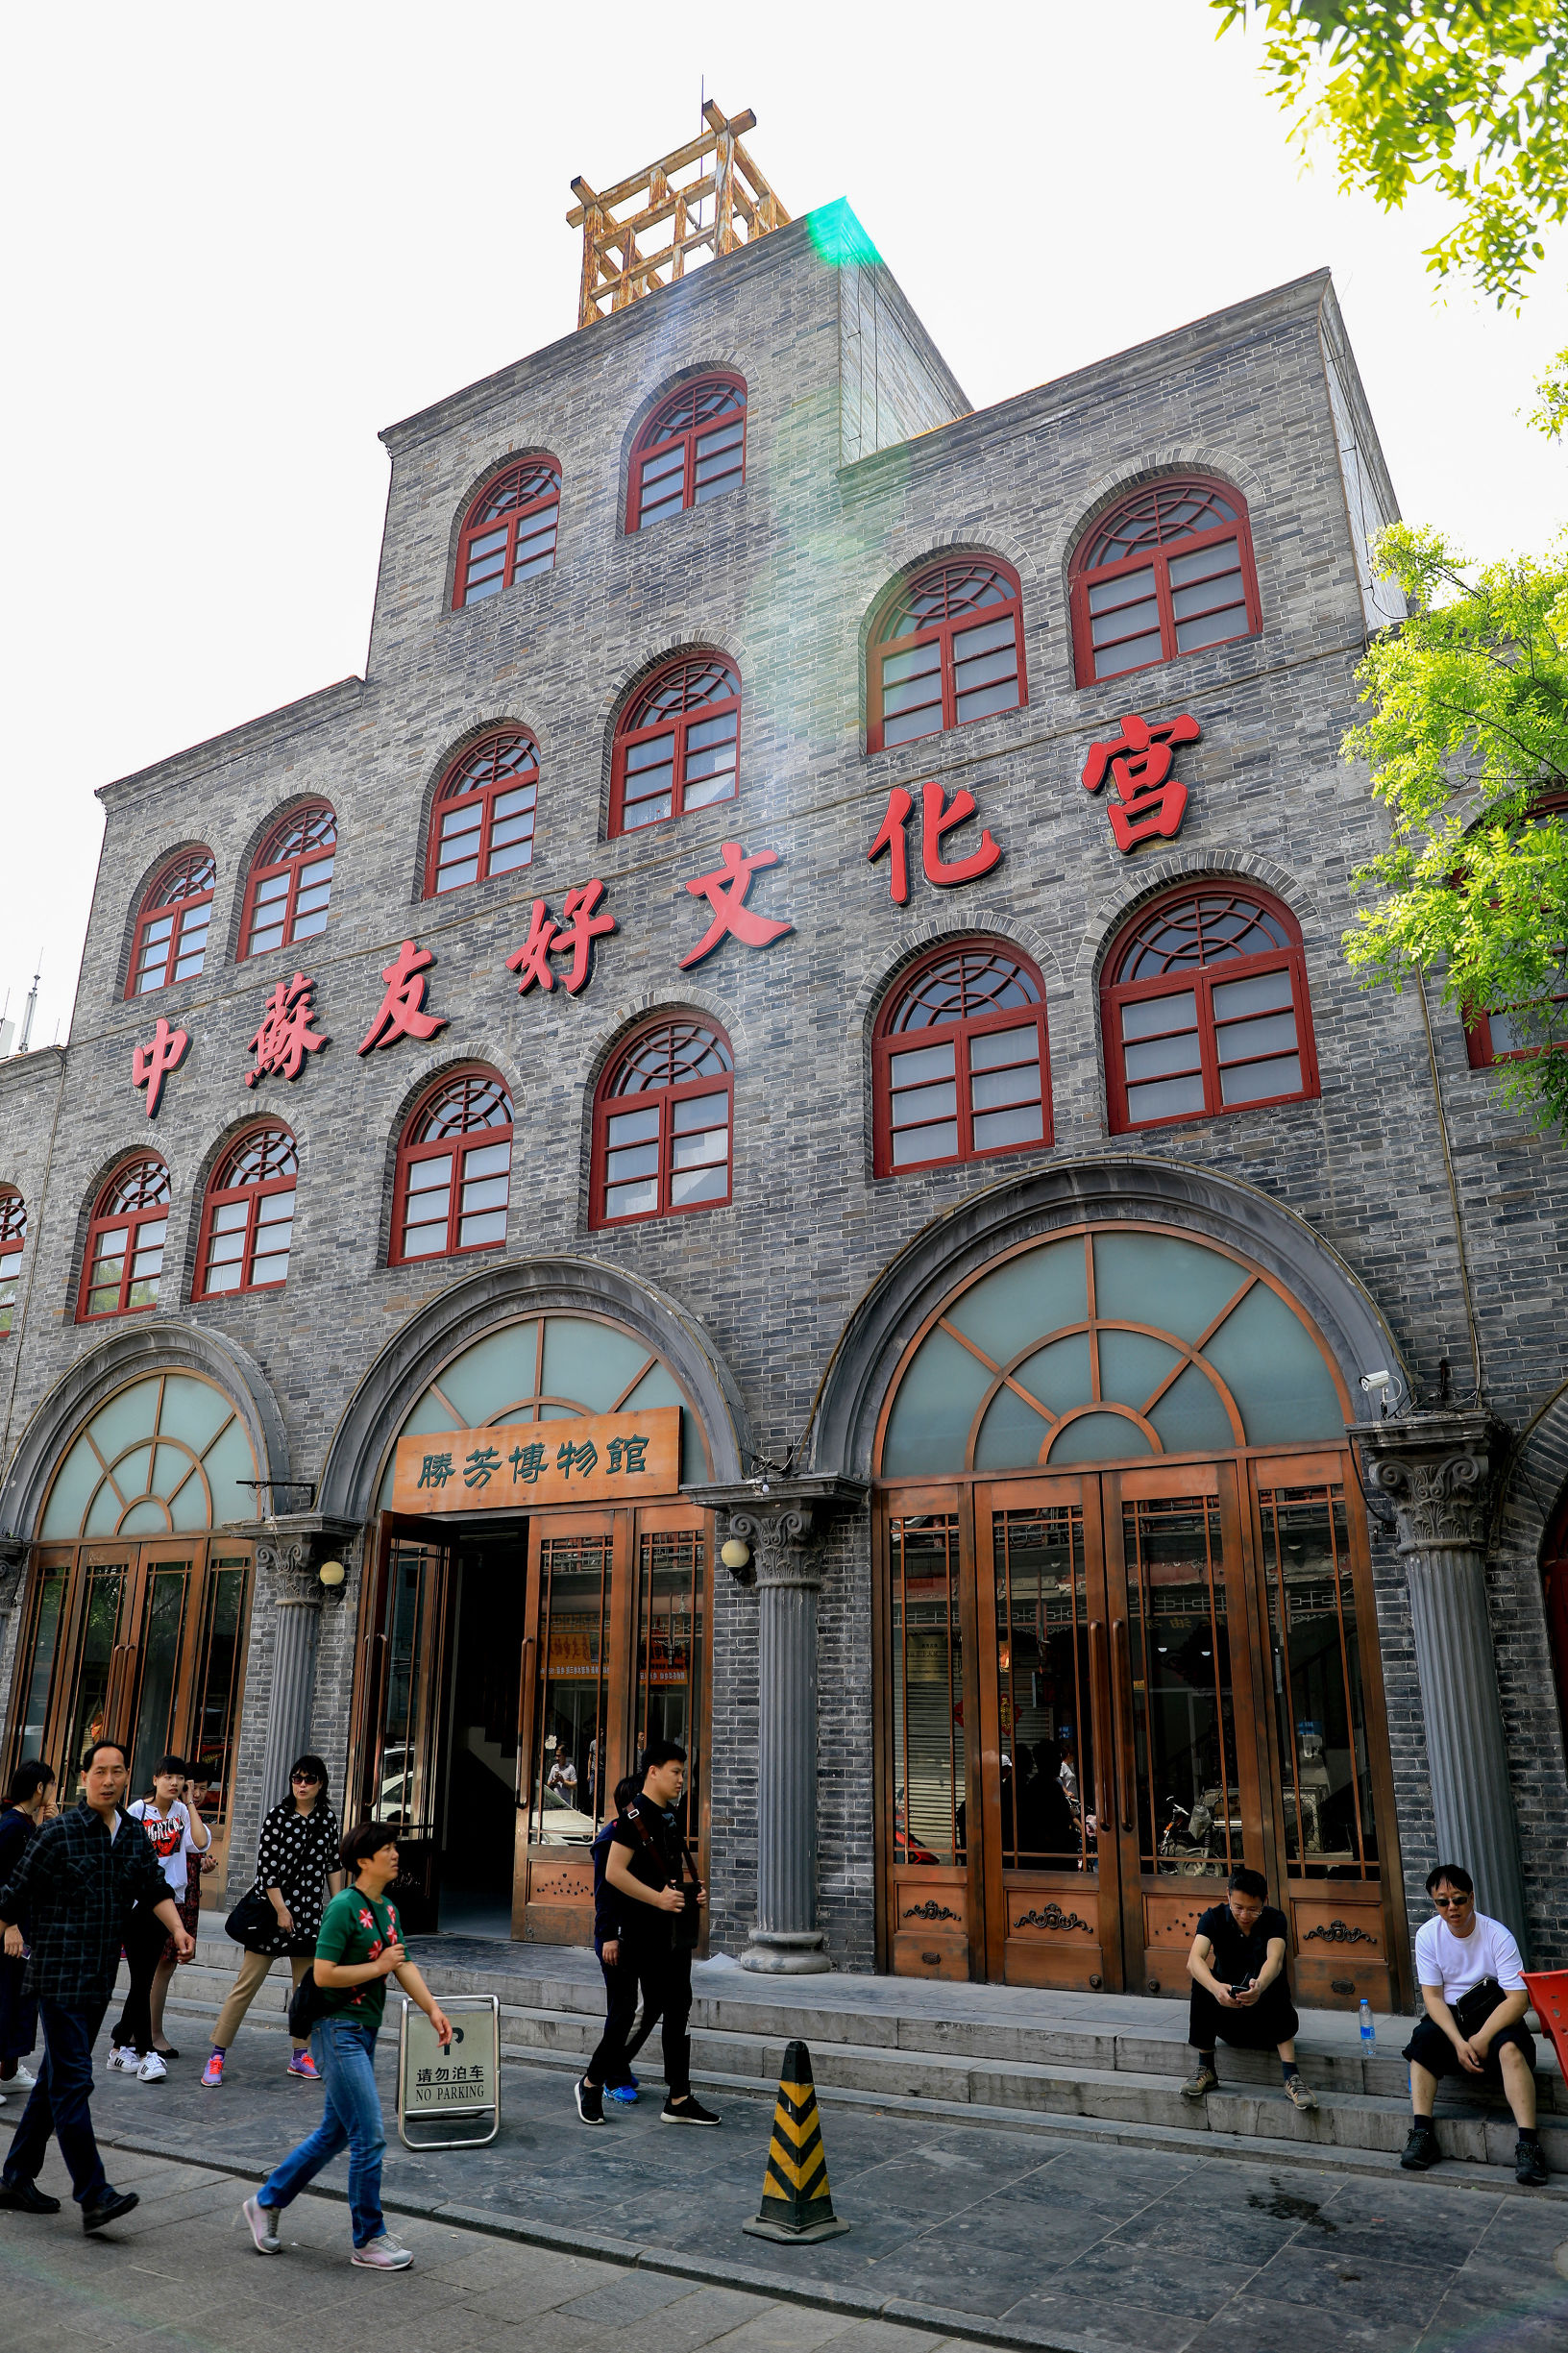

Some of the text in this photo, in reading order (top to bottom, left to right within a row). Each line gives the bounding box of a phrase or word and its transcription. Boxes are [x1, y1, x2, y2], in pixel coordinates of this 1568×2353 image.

[417, 2065, 484, 2083] 请勿泊车
[416, 2085, 484, 2102] NO PARKING
